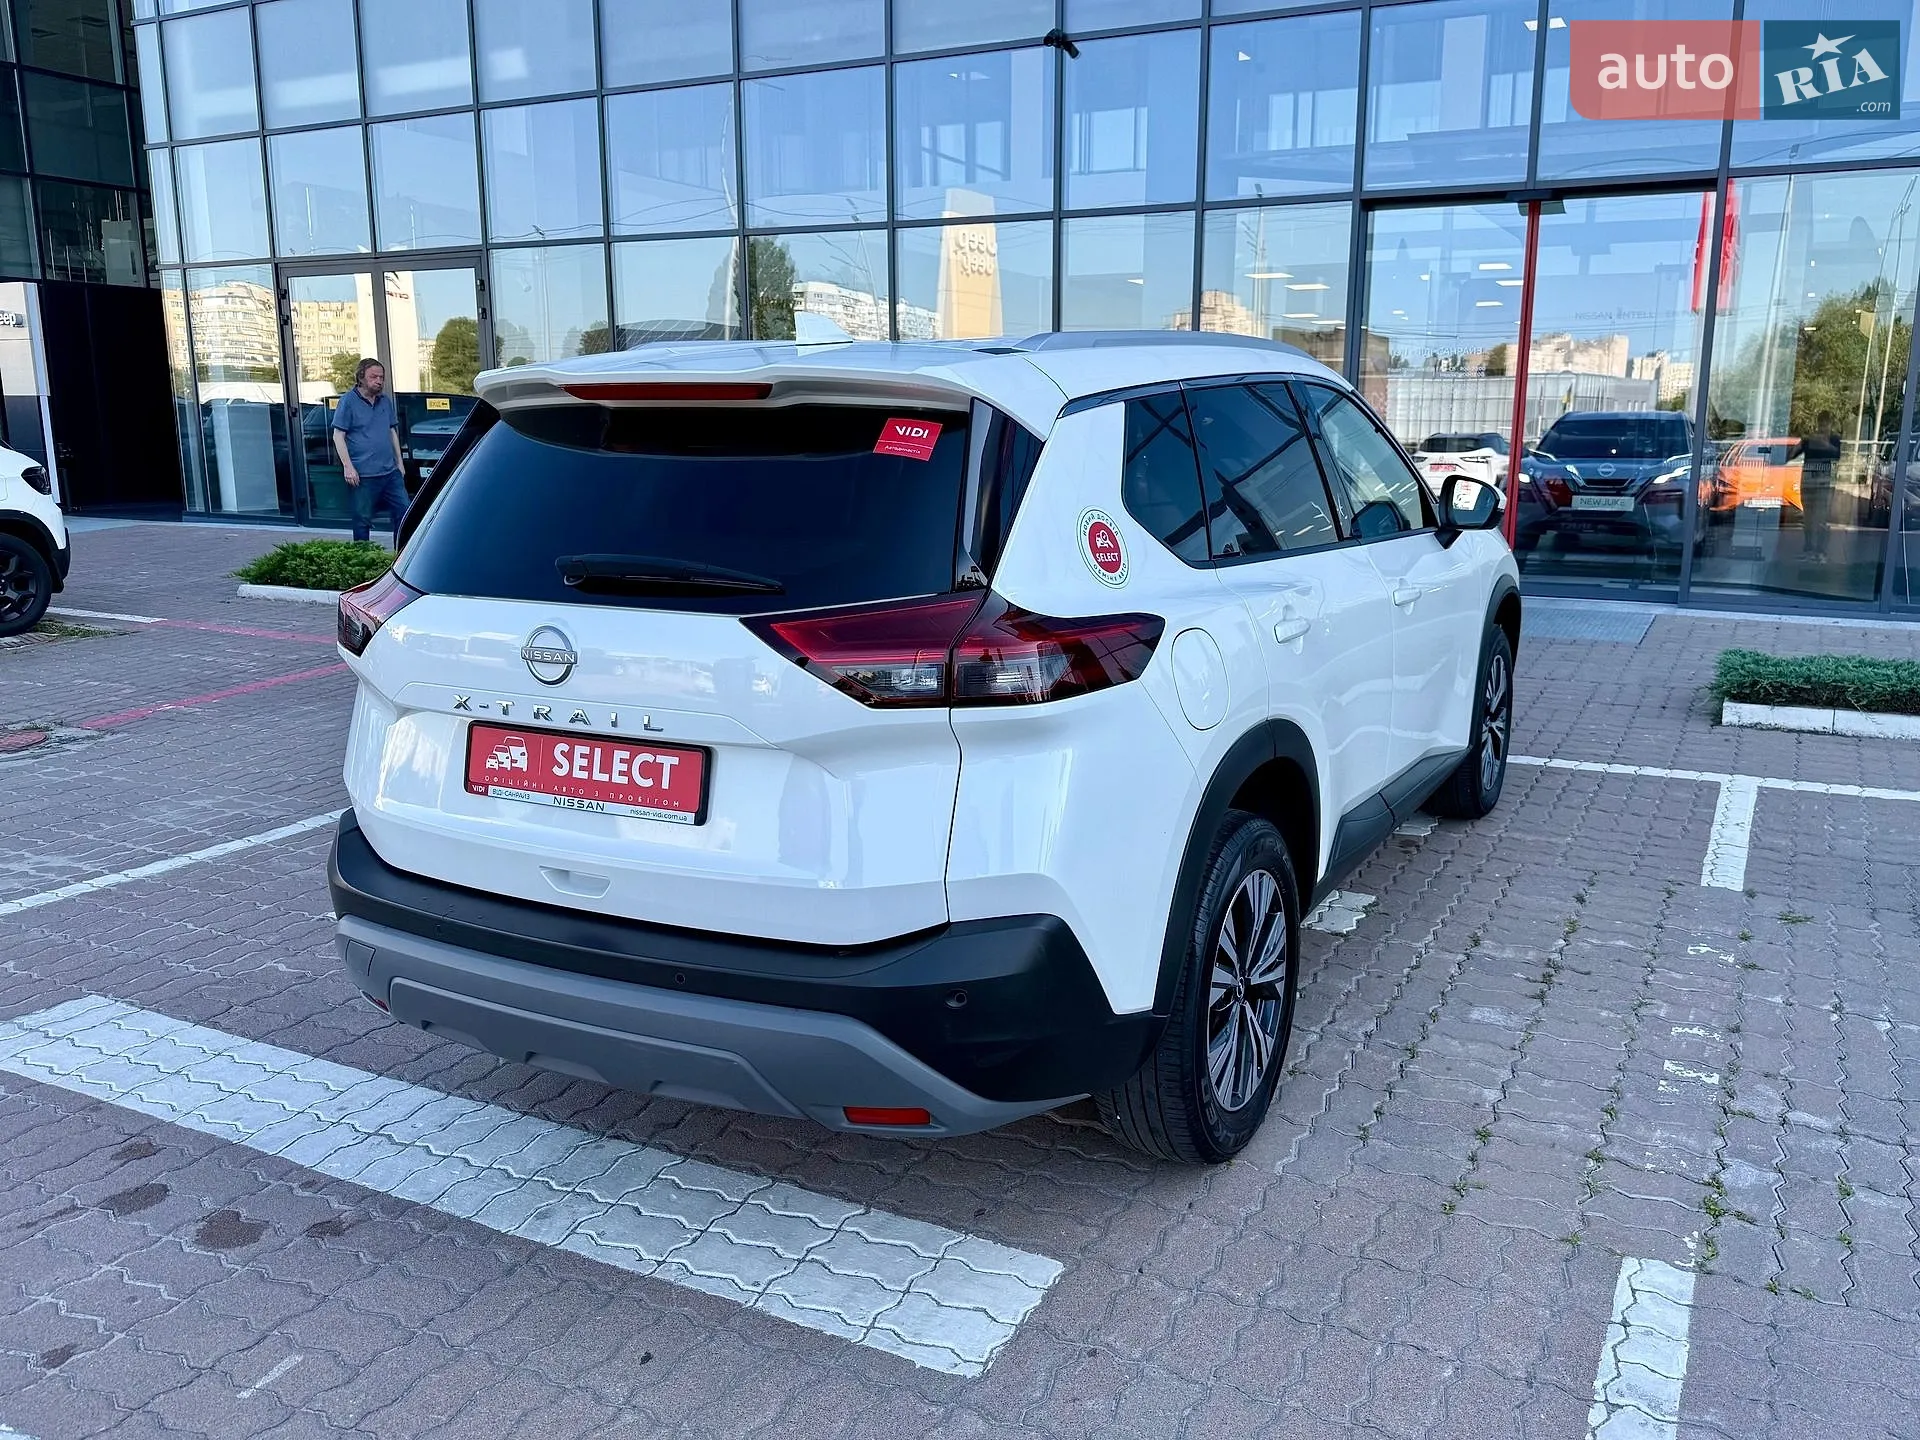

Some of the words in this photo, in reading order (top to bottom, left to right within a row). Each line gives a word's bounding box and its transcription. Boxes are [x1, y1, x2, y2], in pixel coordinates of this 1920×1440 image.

[895, 425, 929, 439] VIDI
[1096, 552, 1119, 562] SELECT
[521, 648, 577, 663] NISSAN
[453, 694, 664, 732] X-TRAIL
[551, 742, 680, 790] SELECT
[471, 784, 487, 793] VIDI
[484, 775, 545, 789] ОФІЦІЙНІ
[553, 785, 585, 795] АВТО
[609, 792, 680, 808] ПРОБІГОМ
[553, 796, 605, 812] NISSAN
[629, 808, 688, 822] nissan-vidi.com.ua
